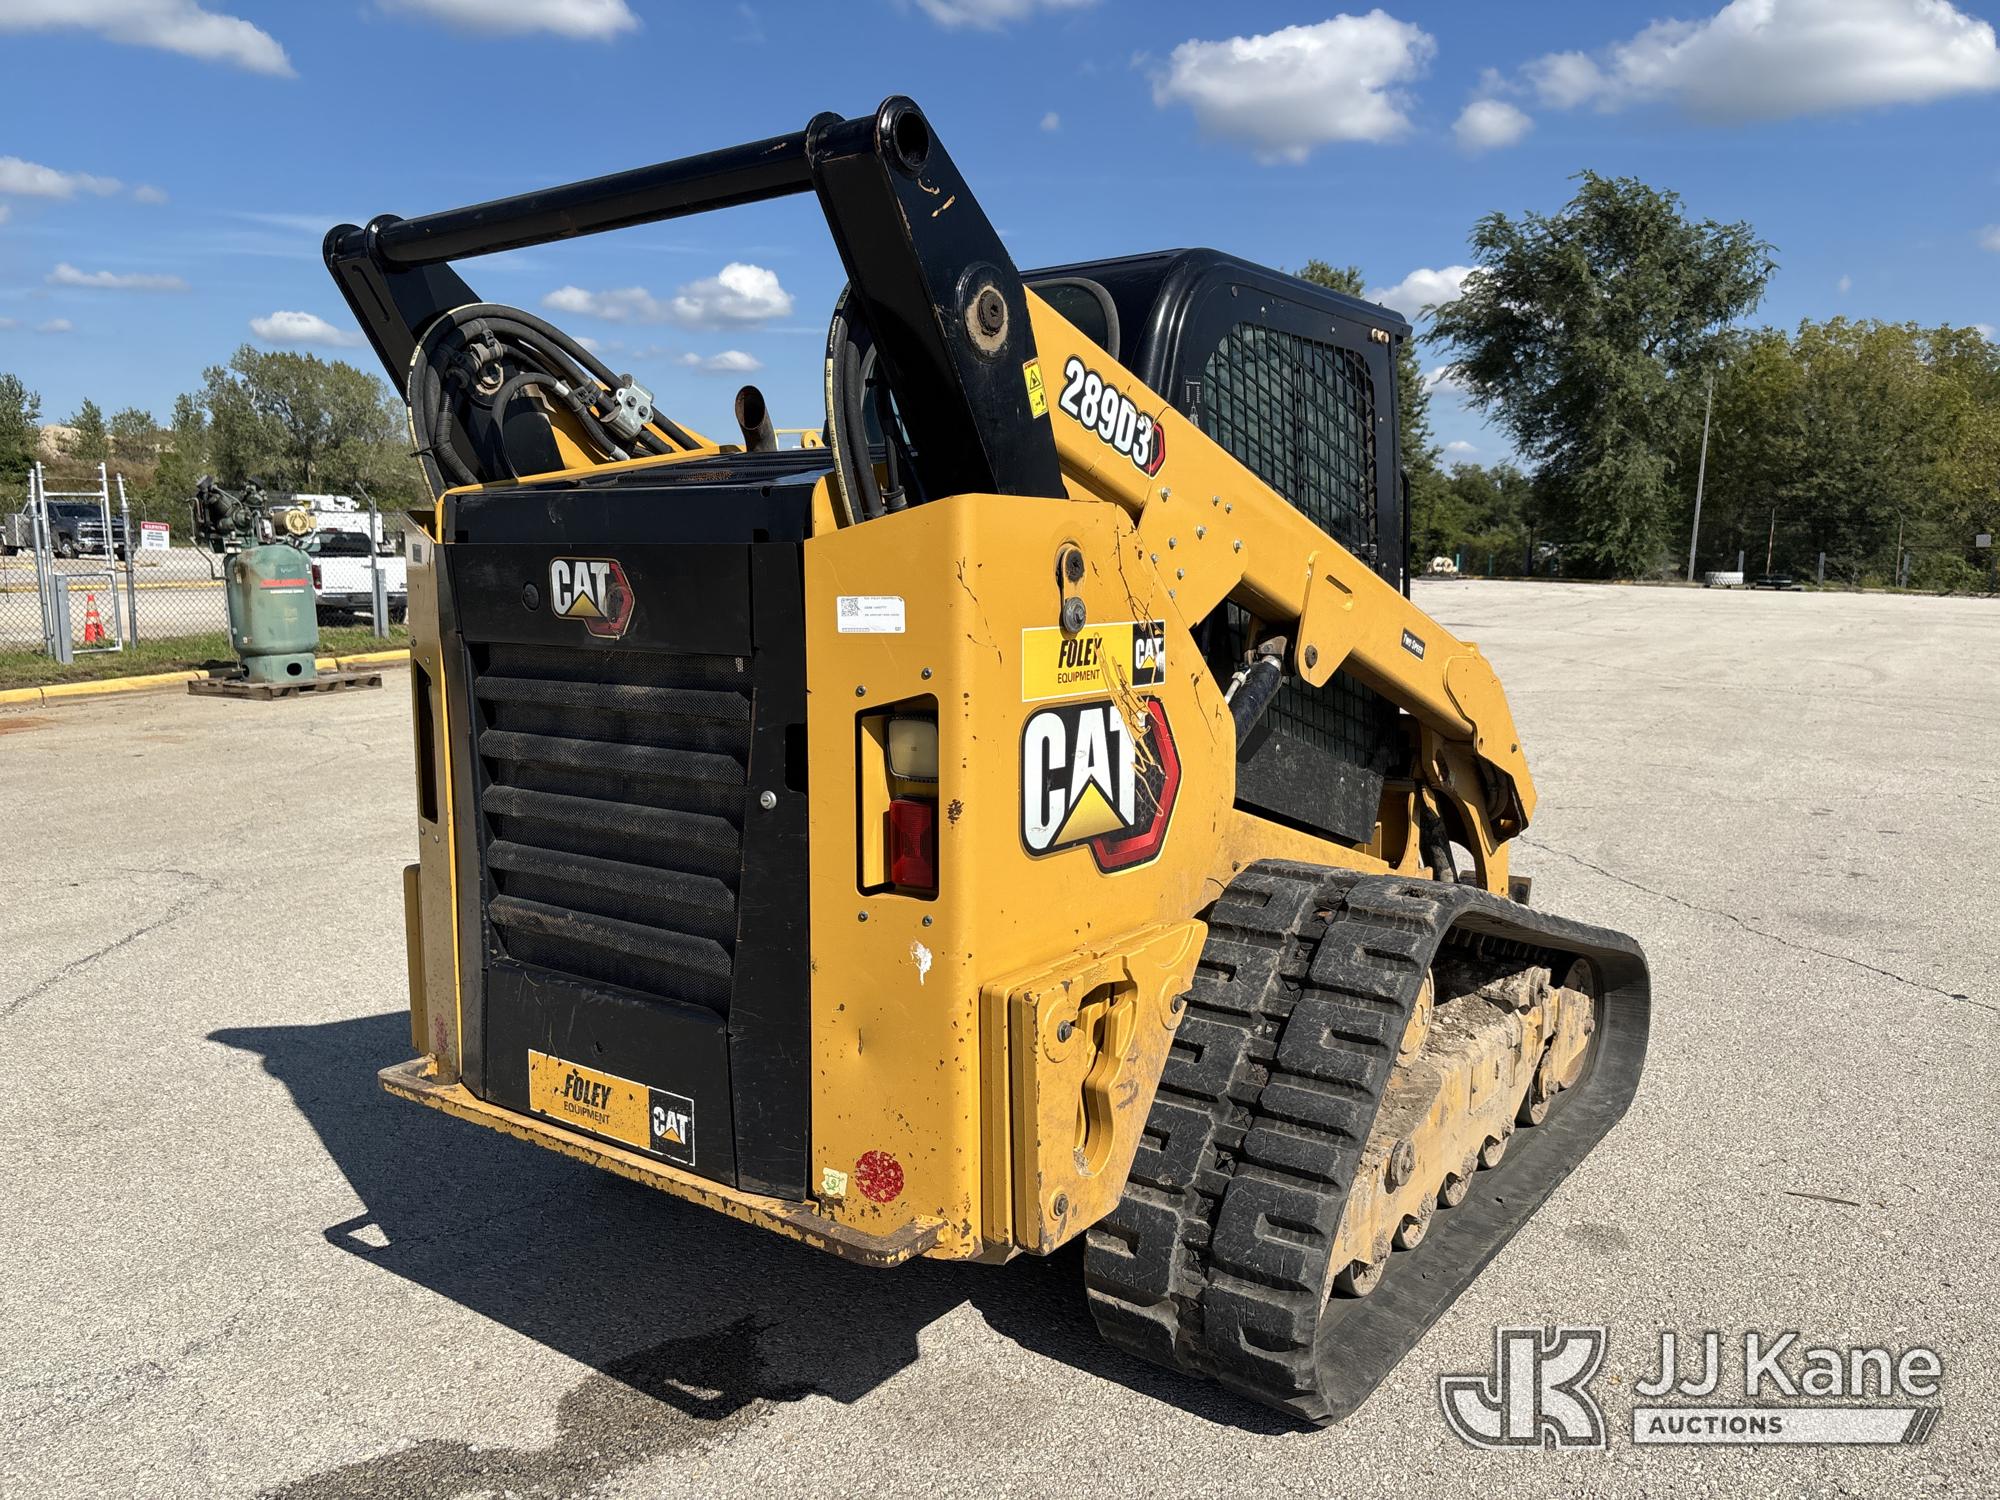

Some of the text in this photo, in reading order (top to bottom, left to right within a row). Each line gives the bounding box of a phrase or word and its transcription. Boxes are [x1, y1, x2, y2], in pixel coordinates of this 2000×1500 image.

[1060, 359, 1152, 466] 289D3
[551, 560, 610, 617] CAT
[1057, 669, 1100, 684] EQUIPMENT
[1058, 637, 1164, 672] FOLEY CAT
[1025, 706, 1146, 849] CAT
[563, 1073, 688, 1144] FOLEY CAT
[563, 1101, 610, 1125] EQUIPMENT
